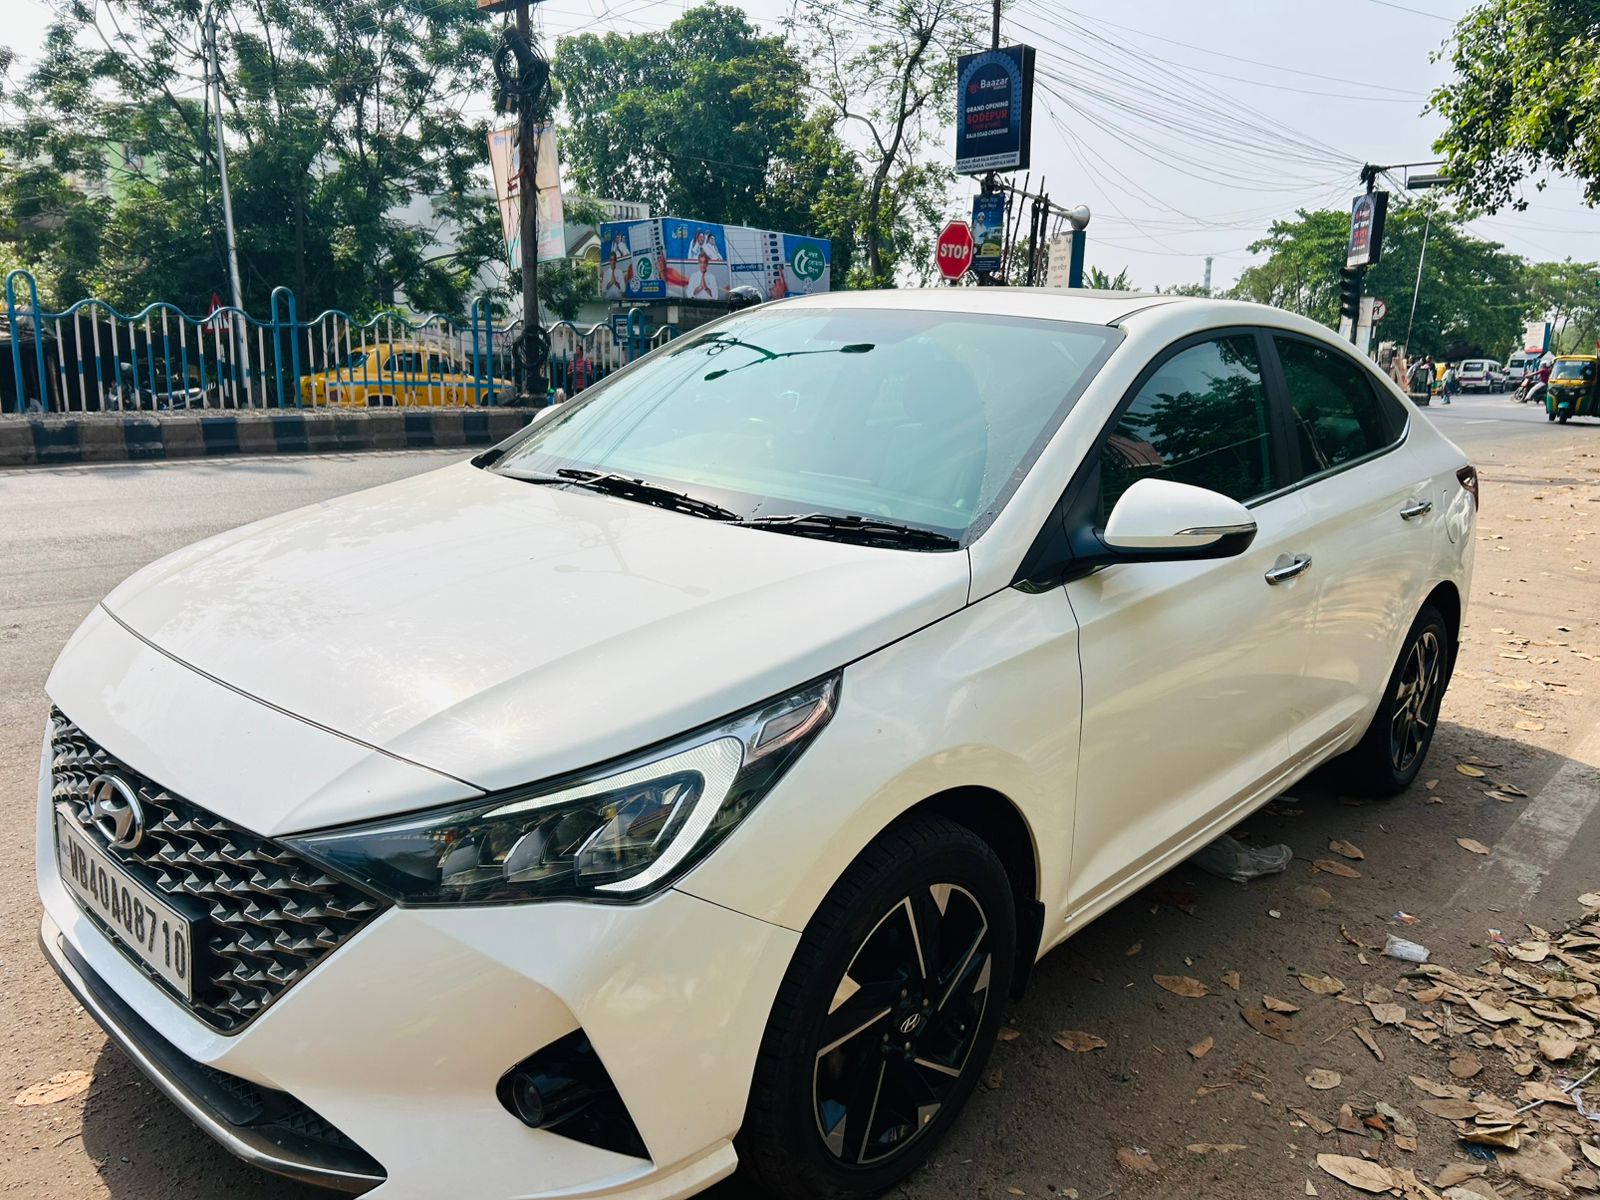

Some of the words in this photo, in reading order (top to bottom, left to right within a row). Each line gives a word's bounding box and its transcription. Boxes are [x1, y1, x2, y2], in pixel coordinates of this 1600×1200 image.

[980, 77, 1009, 89] Baazar
[966, 105, 985, 113] GRAND
[985, 100, 1009, 110] OPENING
[966, 109, 1008, 124] SODEPUR
[940, 243, 969, 260] STOP
